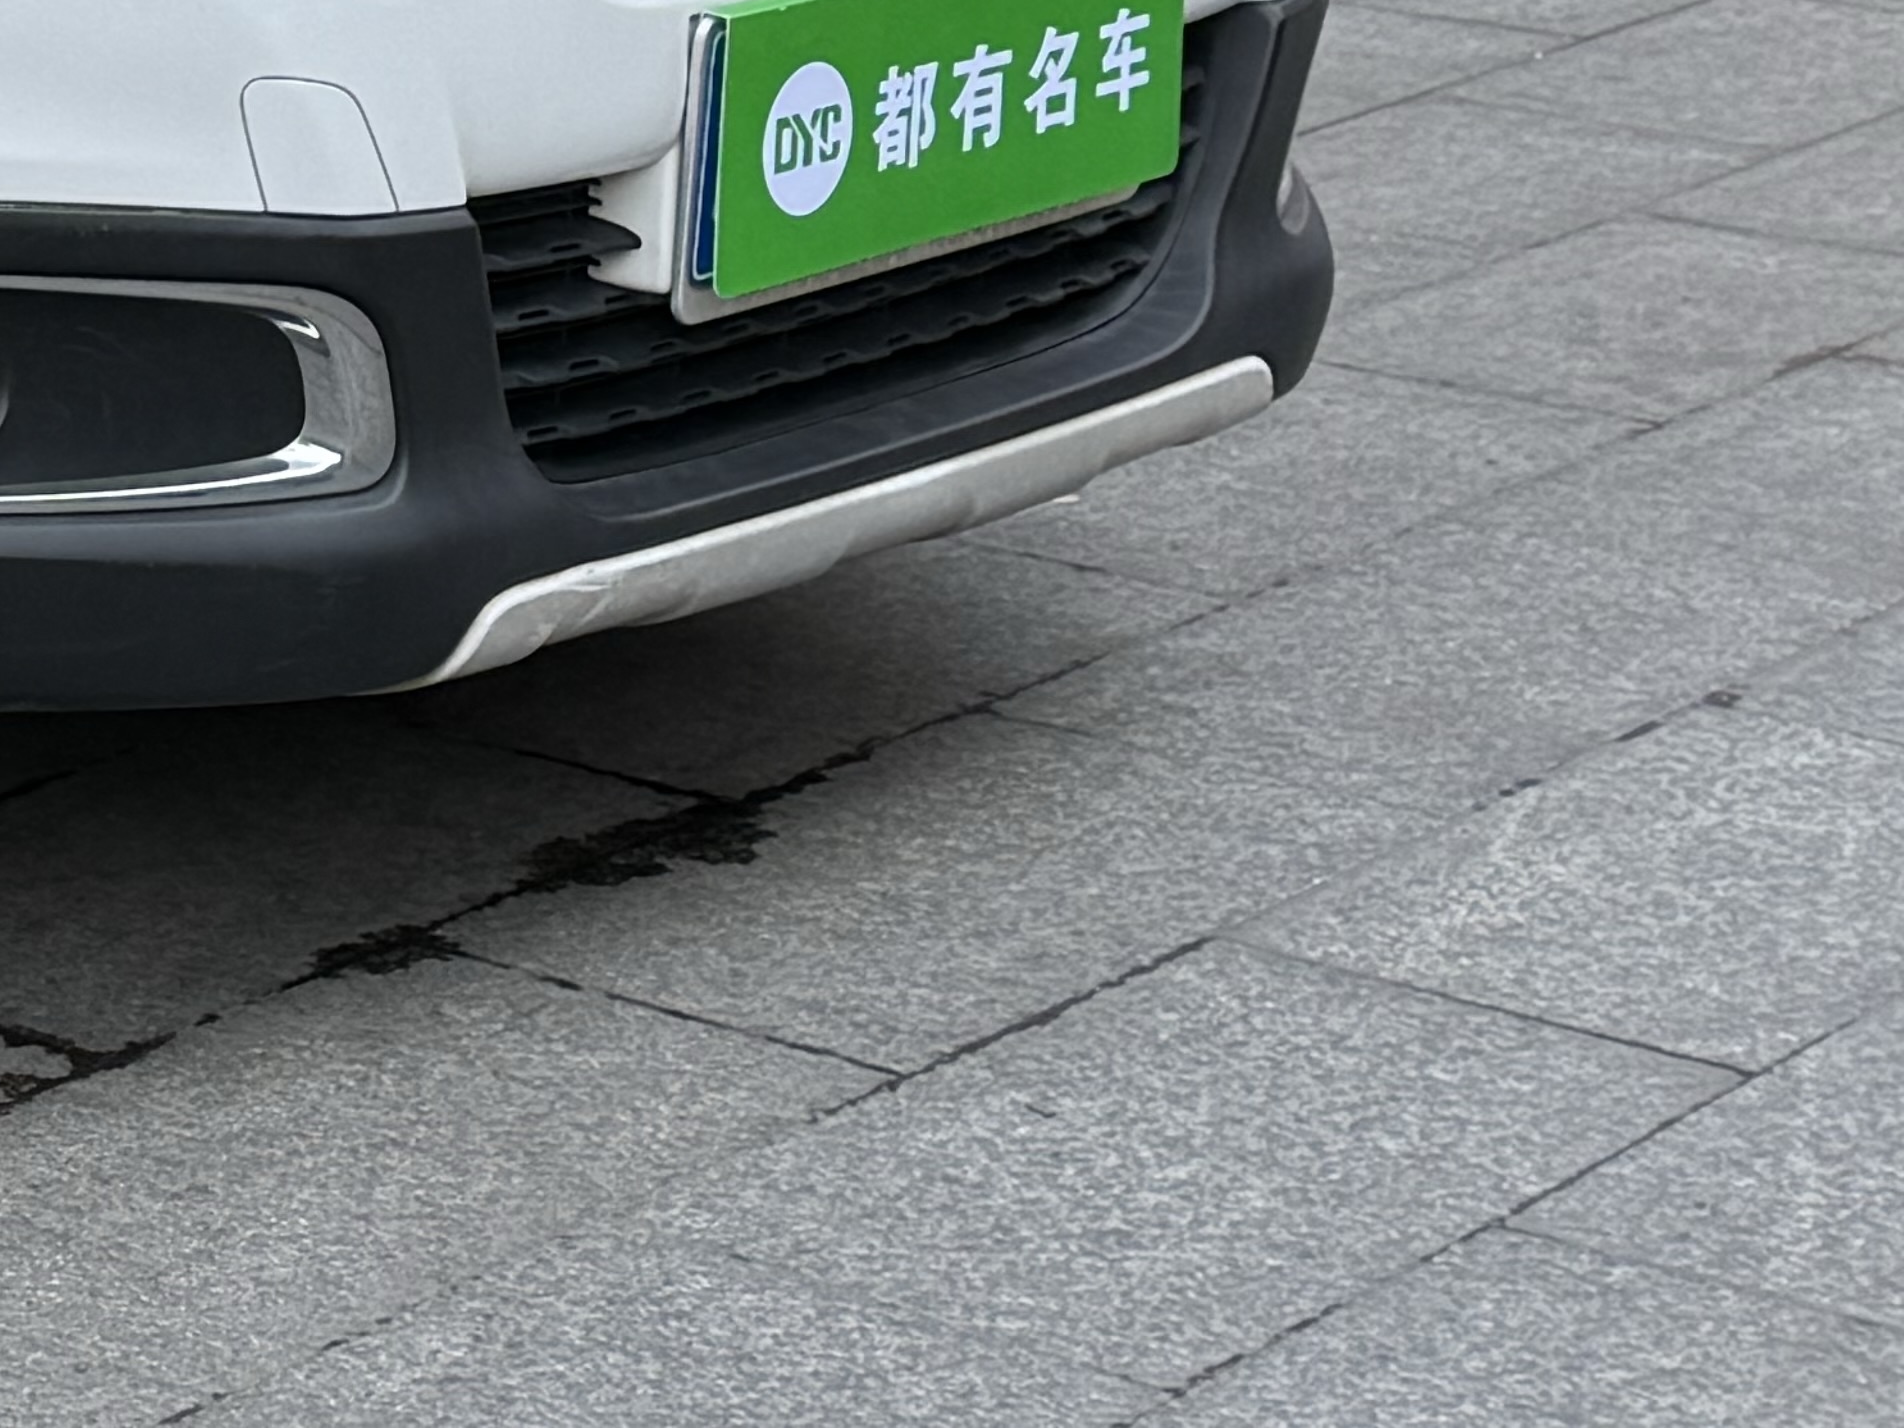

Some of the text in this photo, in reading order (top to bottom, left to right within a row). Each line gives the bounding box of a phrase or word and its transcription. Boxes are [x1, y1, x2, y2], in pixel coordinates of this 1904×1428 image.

[772, 7, 1151, 176] DYC 都有名车
